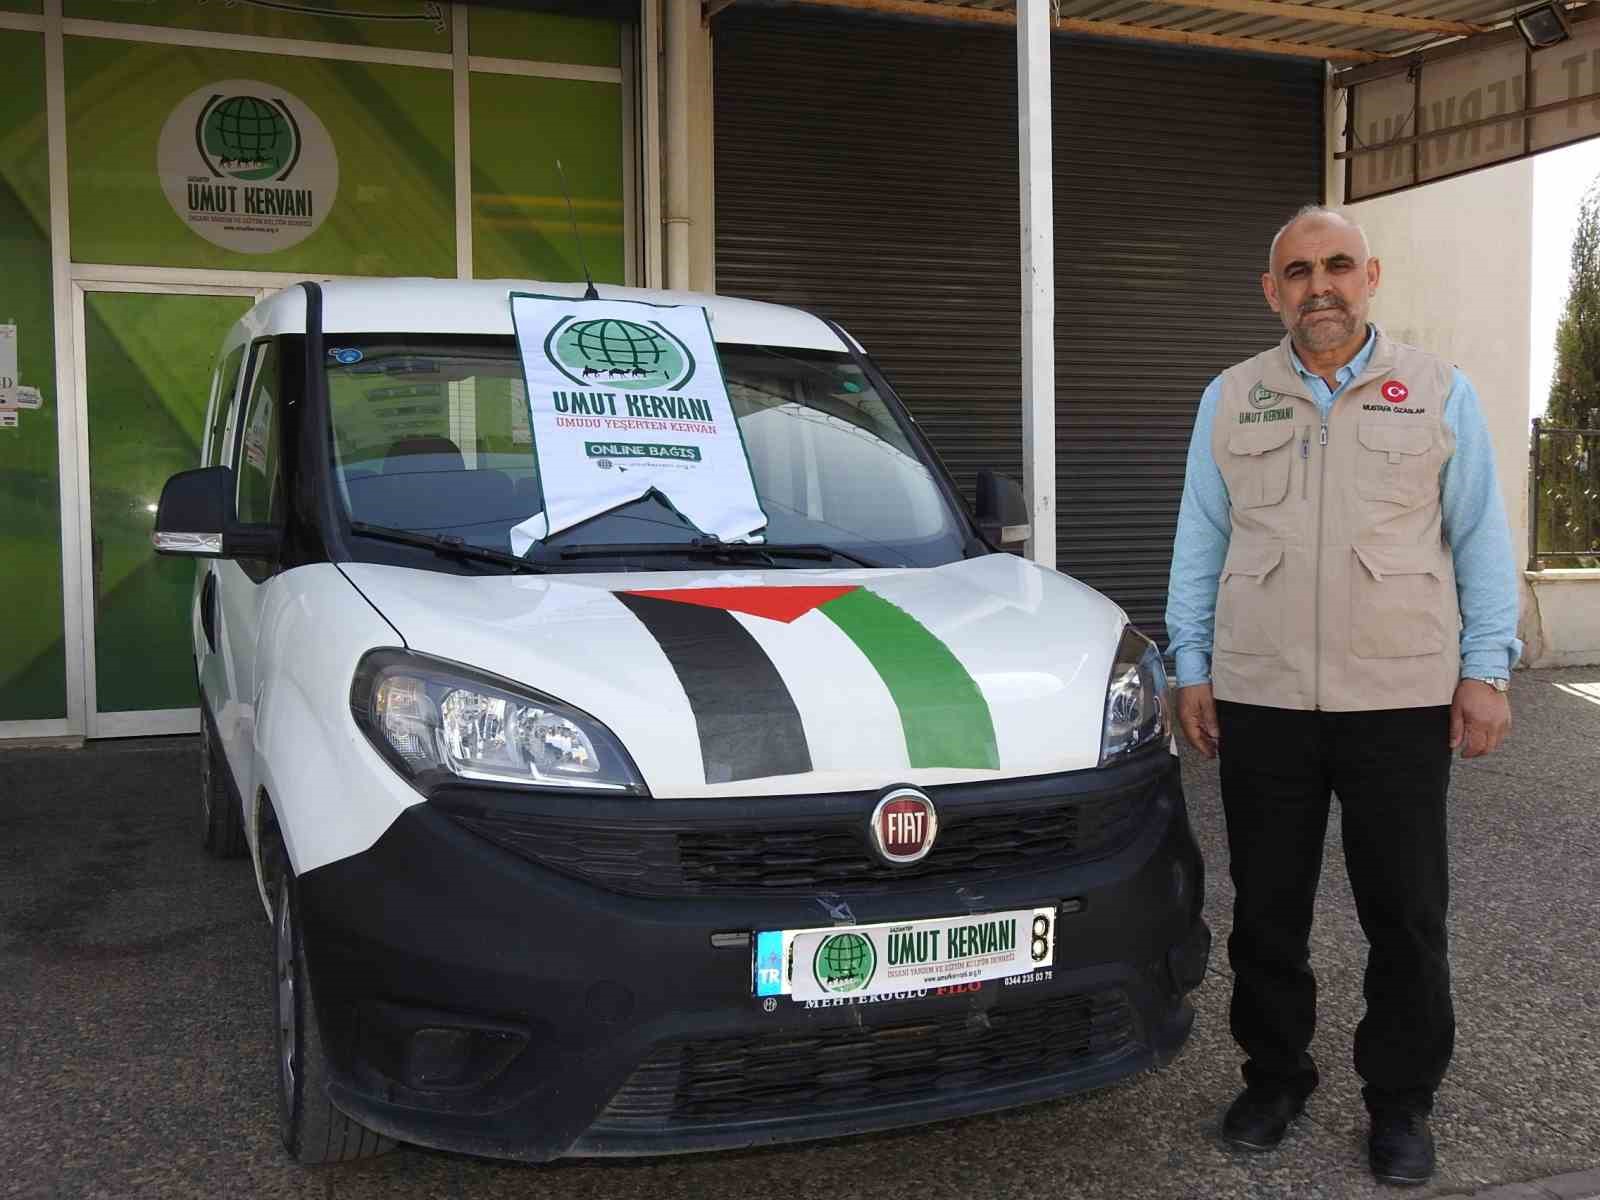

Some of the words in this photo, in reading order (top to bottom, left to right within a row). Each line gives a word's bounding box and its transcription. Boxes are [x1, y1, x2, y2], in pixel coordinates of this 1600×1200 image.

[187, 183, 237, 213] UMUT
[244, 186, 313, 217] KERVANI
[552, 391, 616, 416] UMUT
[624, 394, 713, 421] KERVANI
[1239, 411, 1262, 424] UMUT
[1263, 407, 1294, 422] KERVANI
[556, 417, 601, 428] UMUDU
[605, 419, 667, 431] YEŞERTEN
[671, 423, 717, 434] KERVAN
[591, 444, 645, 456] ONLINE
[887, 811, 925, 845] FIAT
[887, 929, 940, 965] UMUT
[947, 918, 1017, 959] KERVANI
[1031, 914, 1050, 961] 8
[758, 968, 780, 985] TR
